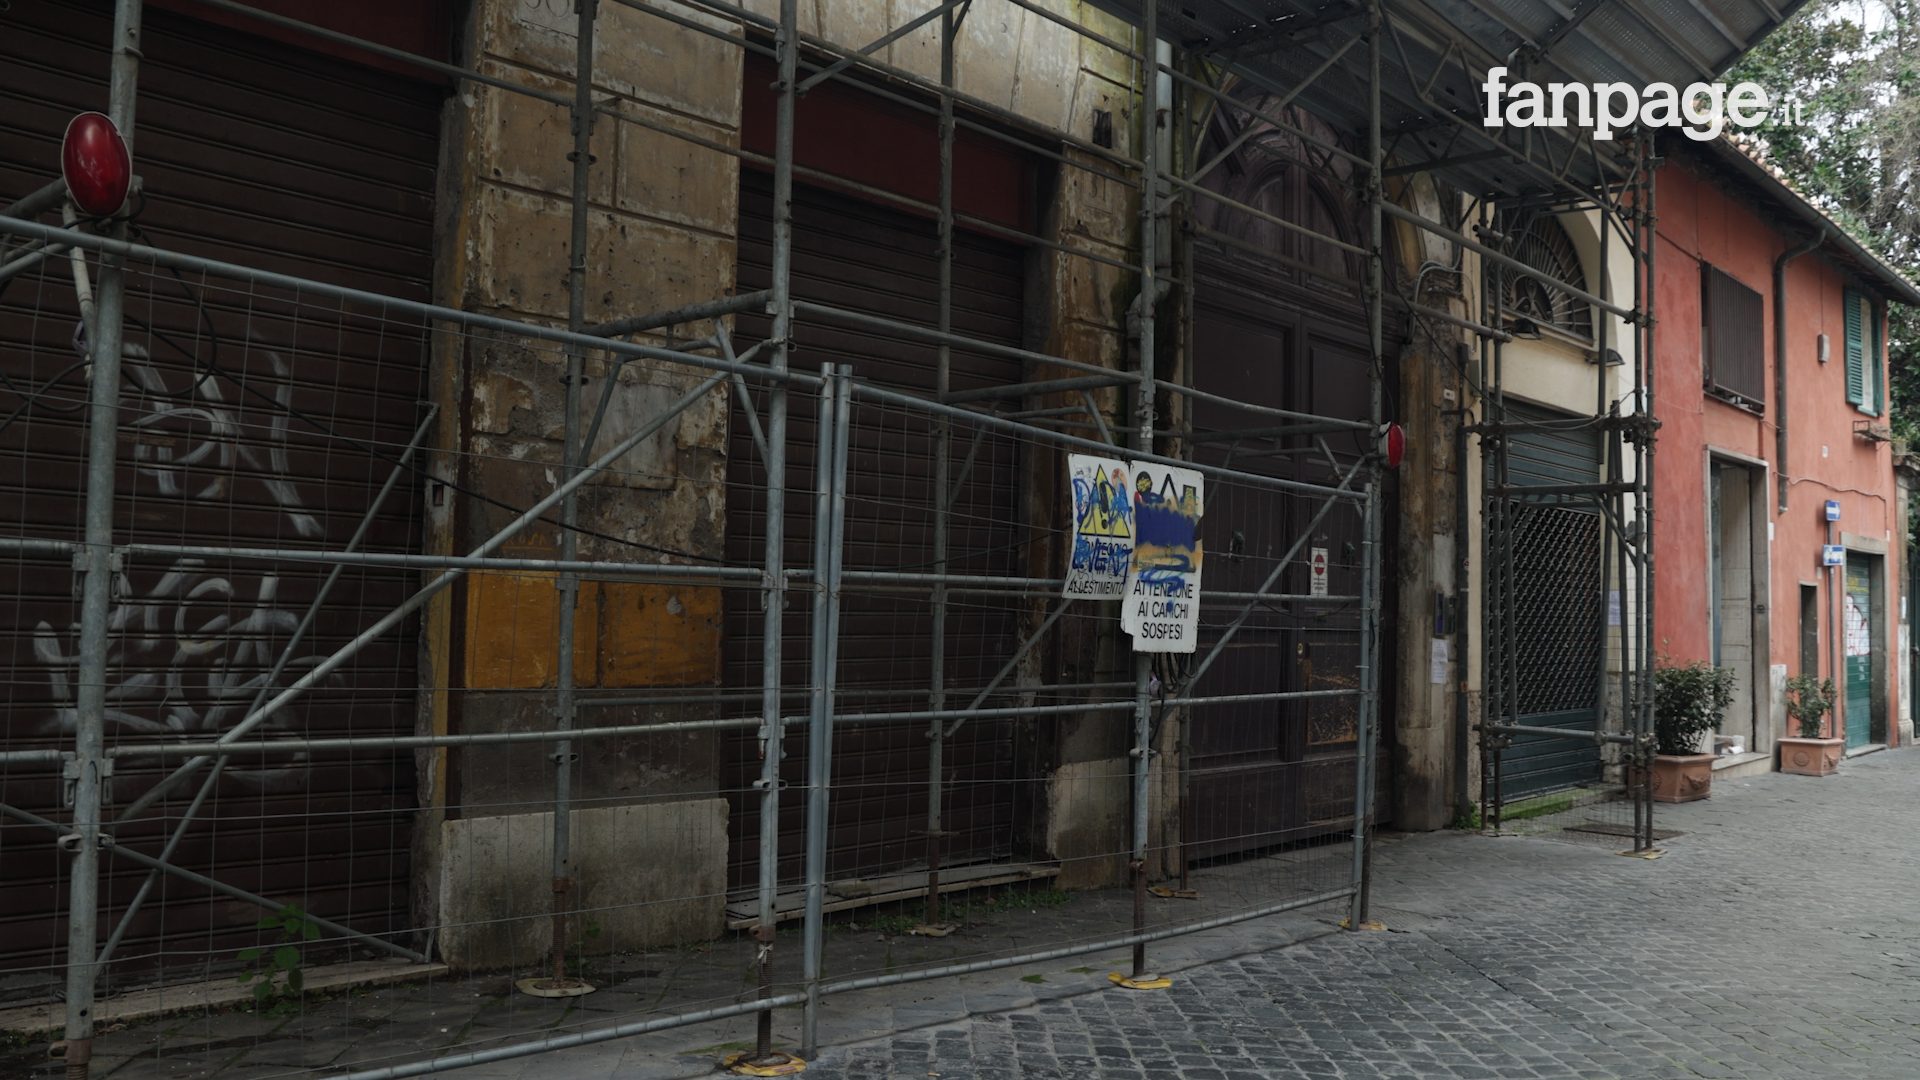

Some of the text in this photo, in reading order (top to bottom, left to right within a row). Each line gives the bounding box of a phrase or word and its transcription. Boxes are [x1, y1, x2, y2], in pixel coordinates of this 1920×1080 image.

[1066, 579, 1125, 595] ALLESTIMENTO
[1137, 601, 1149, 617] AI
[1141, 622, 1183, 640] SOSPESI
